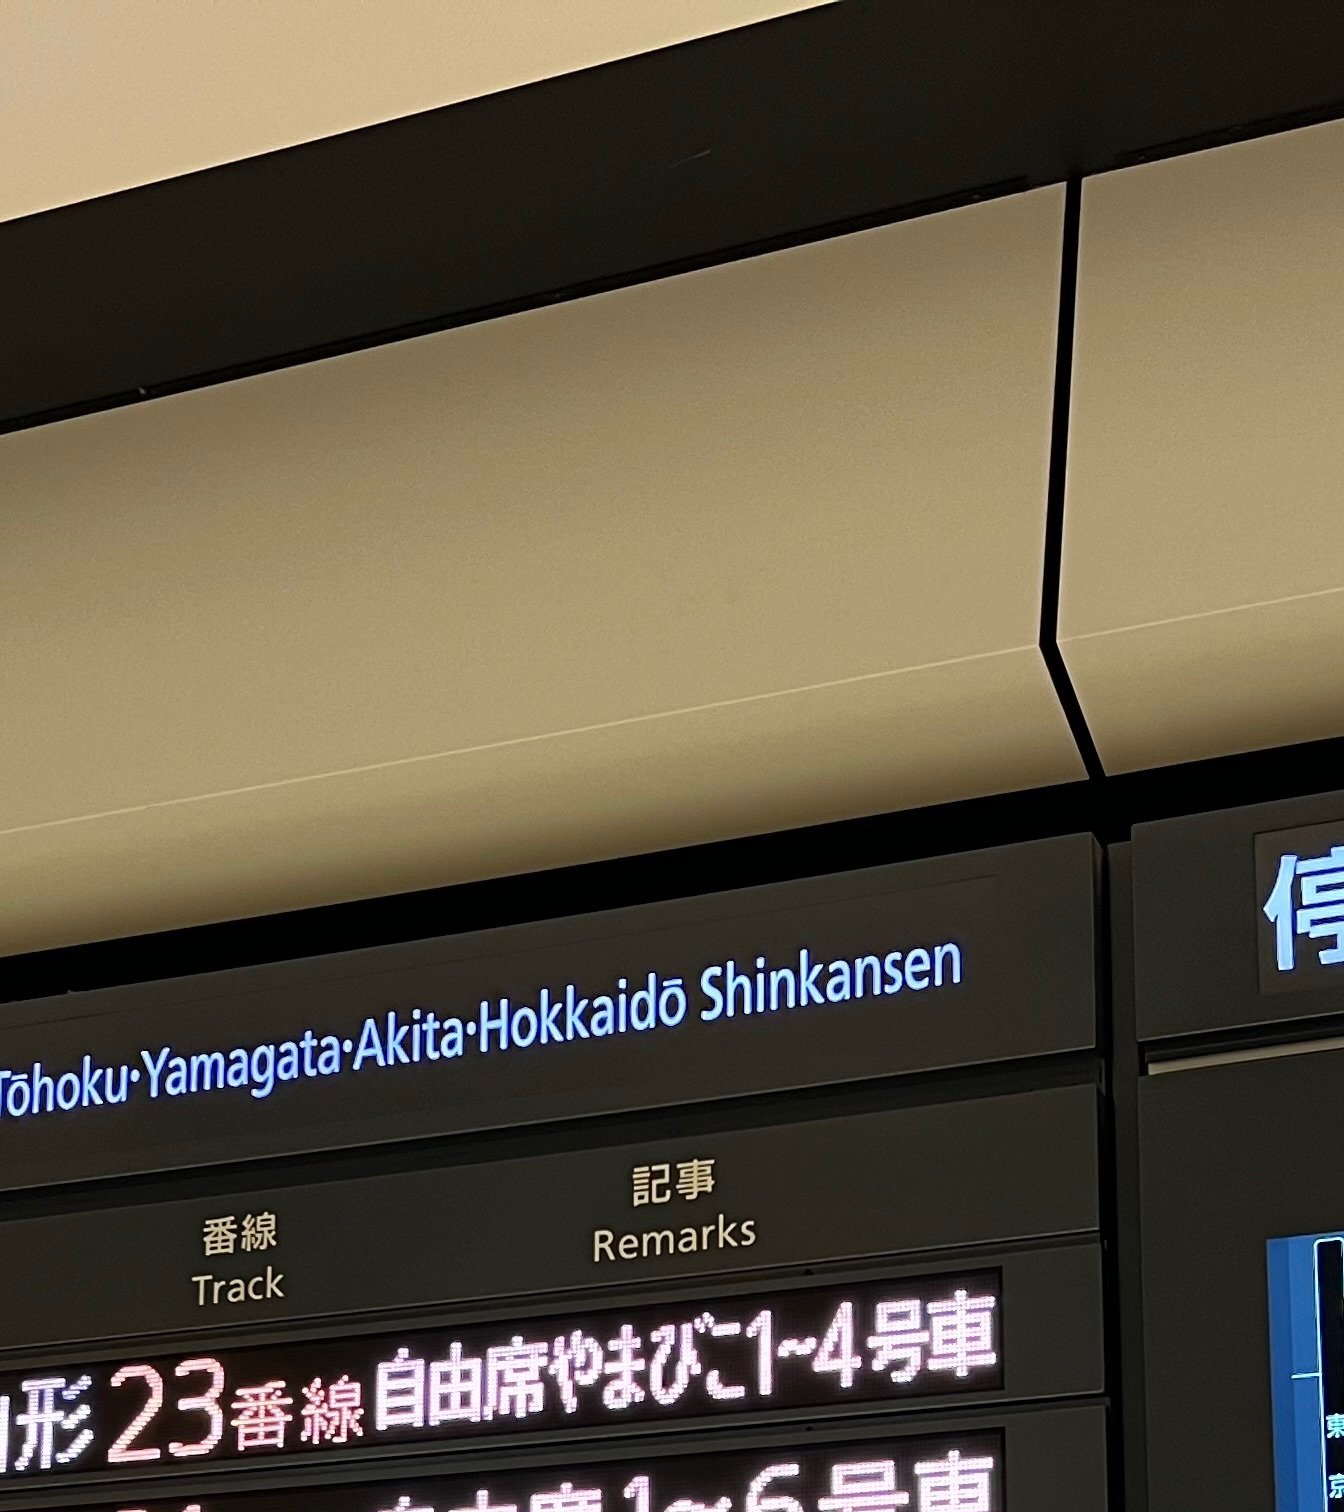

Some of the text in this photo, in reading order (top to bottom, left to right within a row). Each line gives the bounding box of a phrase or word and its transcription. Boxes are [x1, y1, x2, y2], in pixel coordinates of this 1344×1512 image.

[700, 940, 963, 1021] Shinkansen
[632, 1158, 716, 1208] 記事
[201, 1211, 278, 1257] 番線
[592, 1213, 757, 1263] Remarks
[191, 1265, 286, 1308] Track
[106, 1357, 365, 1464] 23番線
